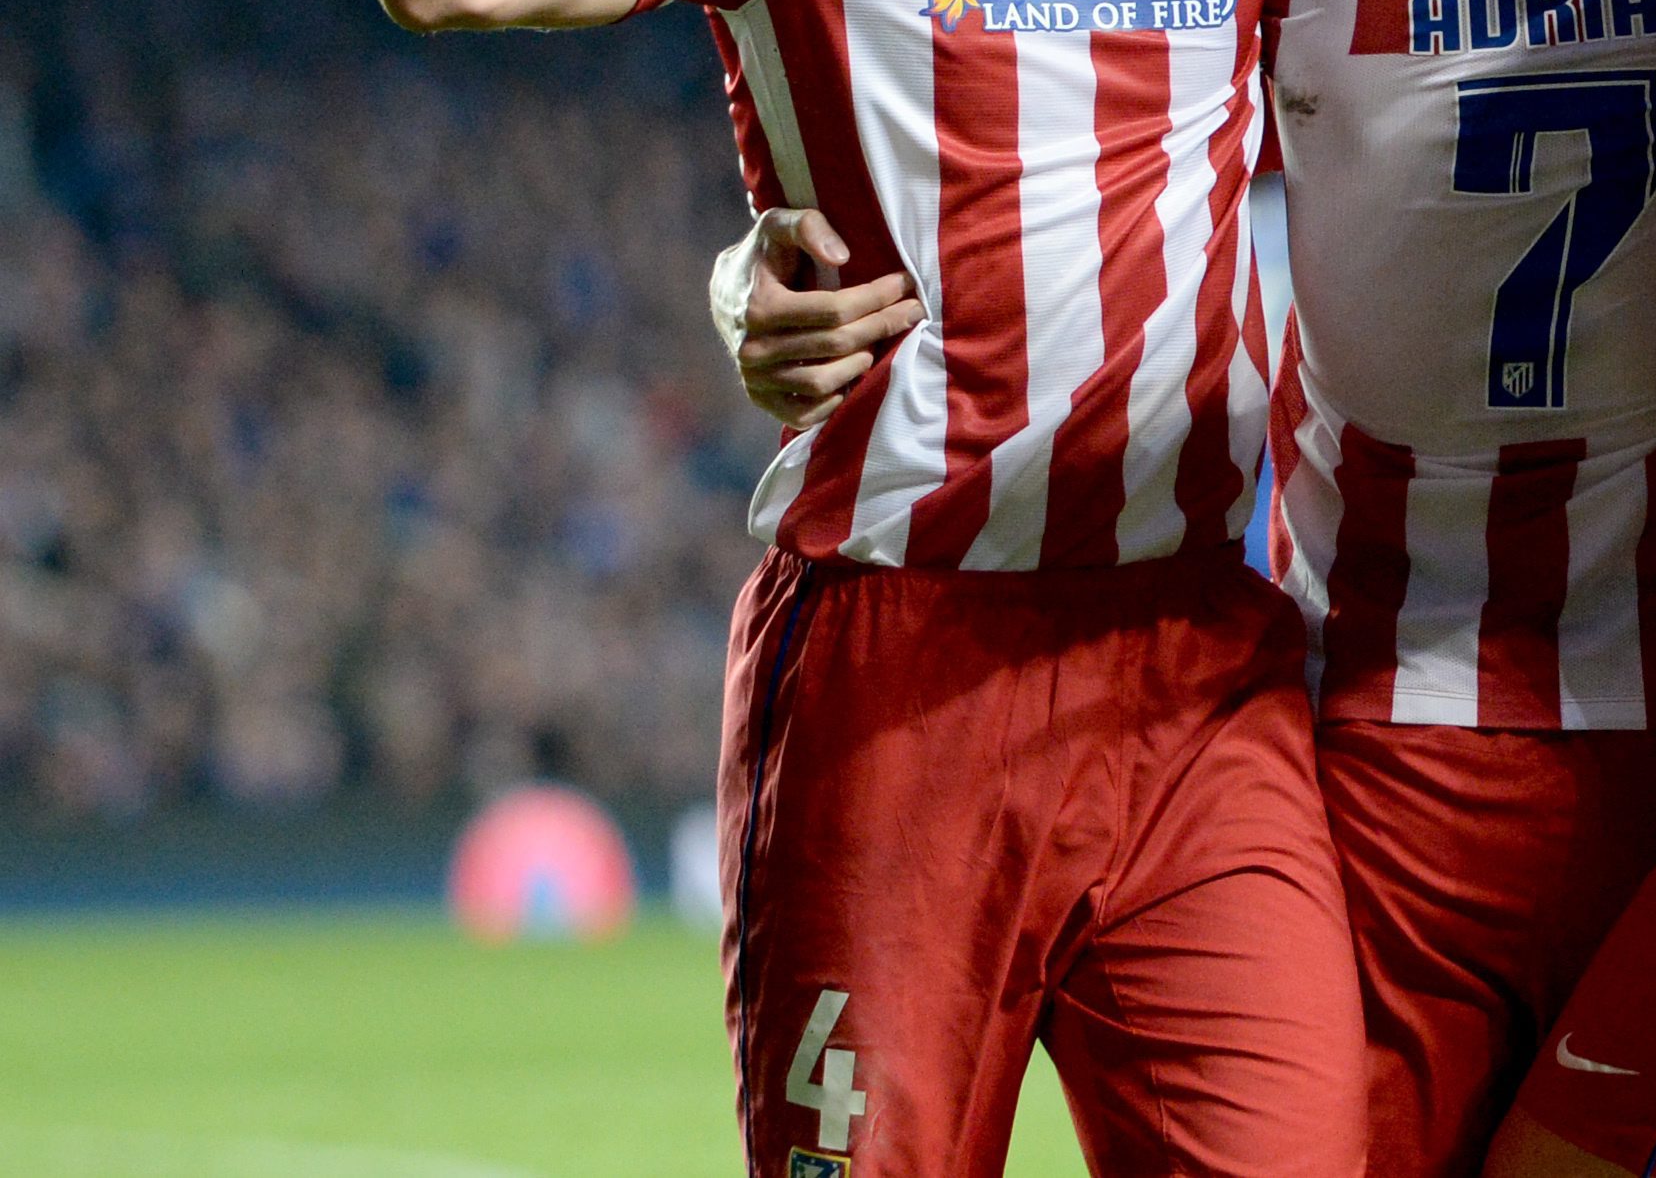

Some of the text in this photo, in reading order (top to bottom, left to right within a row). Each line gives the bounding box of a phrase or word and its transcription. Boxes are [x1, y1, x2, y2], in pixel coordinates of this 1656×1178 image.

[984, 0, 1221, 30] LAND OF FIRE
[786, 989, 867, 1151] 4
